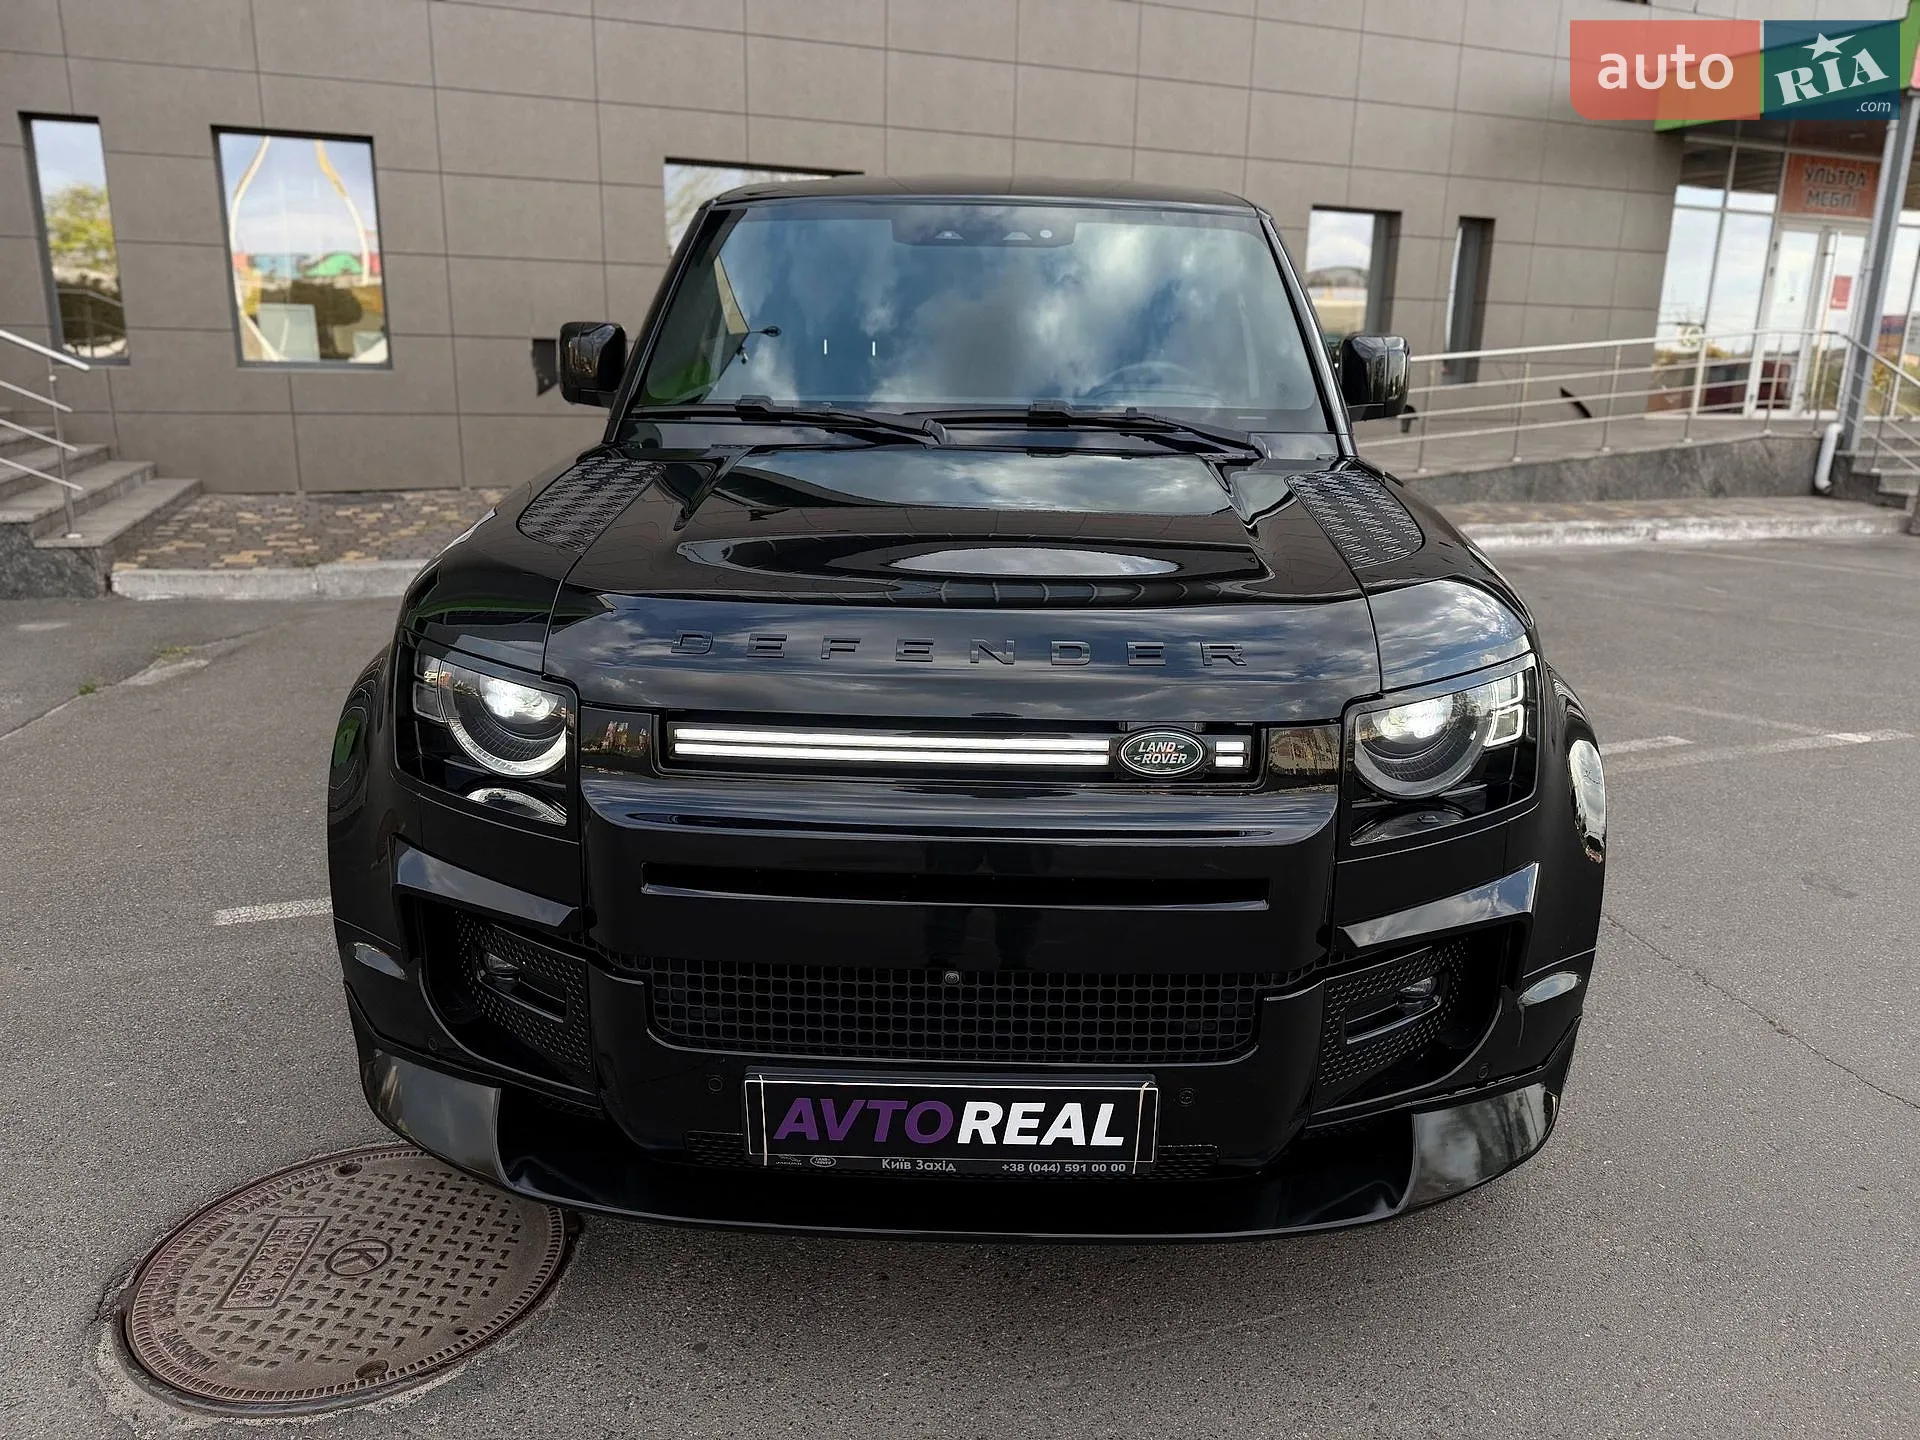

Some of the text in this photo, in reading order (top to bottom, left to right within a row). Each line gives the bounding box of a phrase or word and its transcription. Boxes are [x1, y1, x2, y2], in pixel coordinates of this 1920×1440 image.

[670, 630, 1248, 666] DEFENDER
[1138, 741, 1177, 753] LAND
[1141, 753, 1187, 764] ROVER
[773, 1096, 1124, 1147] AVTOREAL
[881, 1158, 957, 1173] Київ Захід
[1001, 1163, 1126, 1174] +38 (044) 591 00 00
